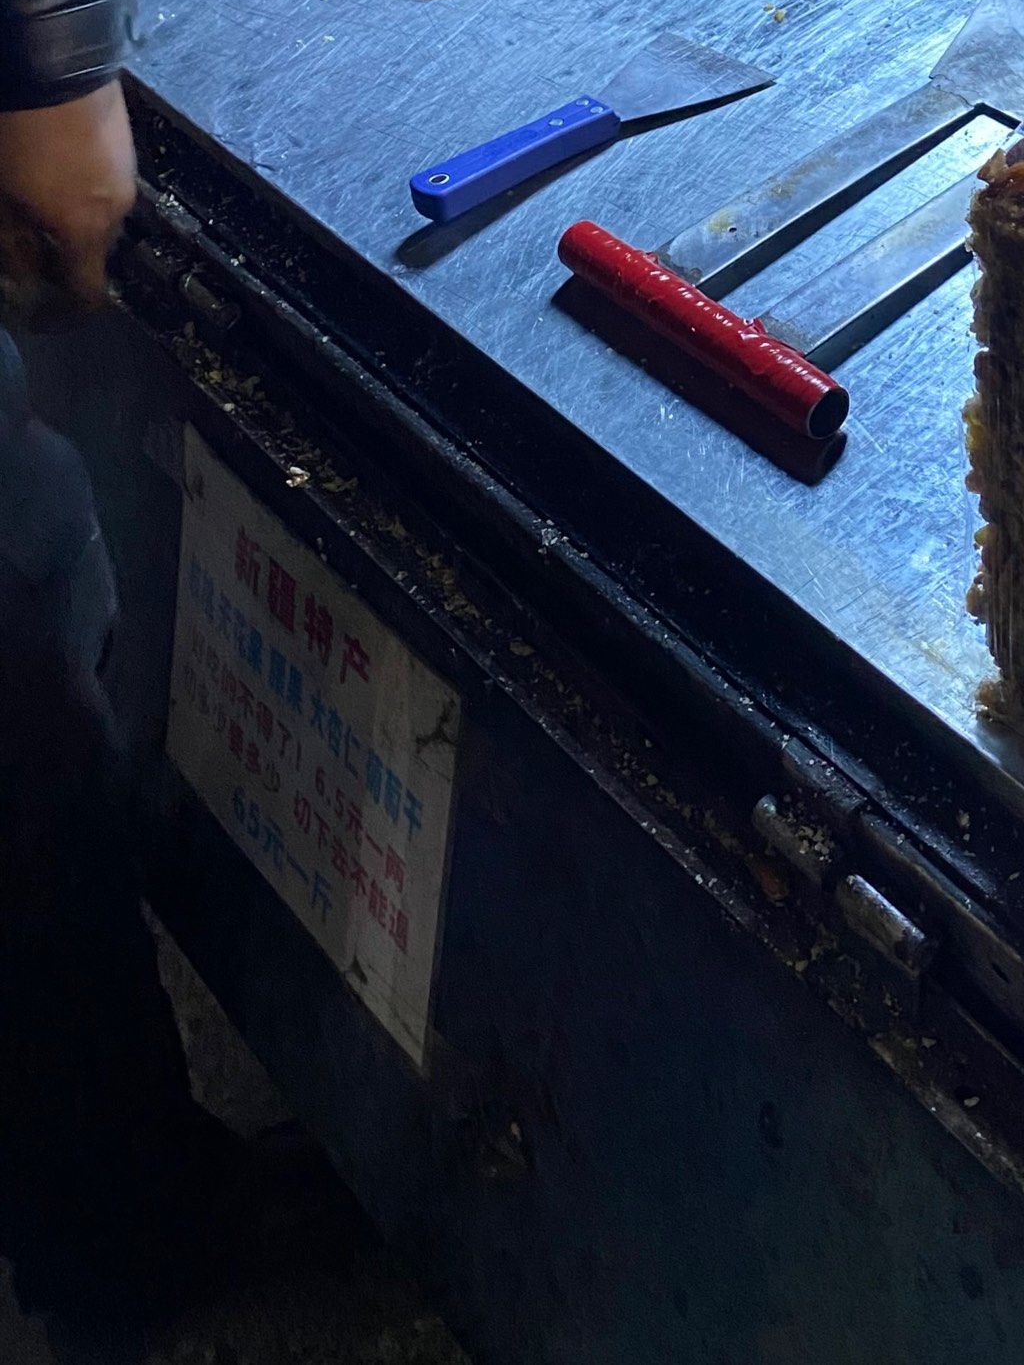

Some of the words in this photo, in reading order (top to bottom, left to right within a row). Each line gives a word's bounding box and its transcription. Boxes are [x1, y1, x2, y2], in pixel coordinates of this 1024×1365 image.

[235, 525, 369, 683] 新疆特产
[310, 691, 360, 779] 大杏仁
[367, 747, 423, 838] 葡萄干
[315, 766, 405, 893] 6.5元一两
[233, 785, 333, 923] 65元一斤
[294, 792, 409, 954] 切下去不能退
